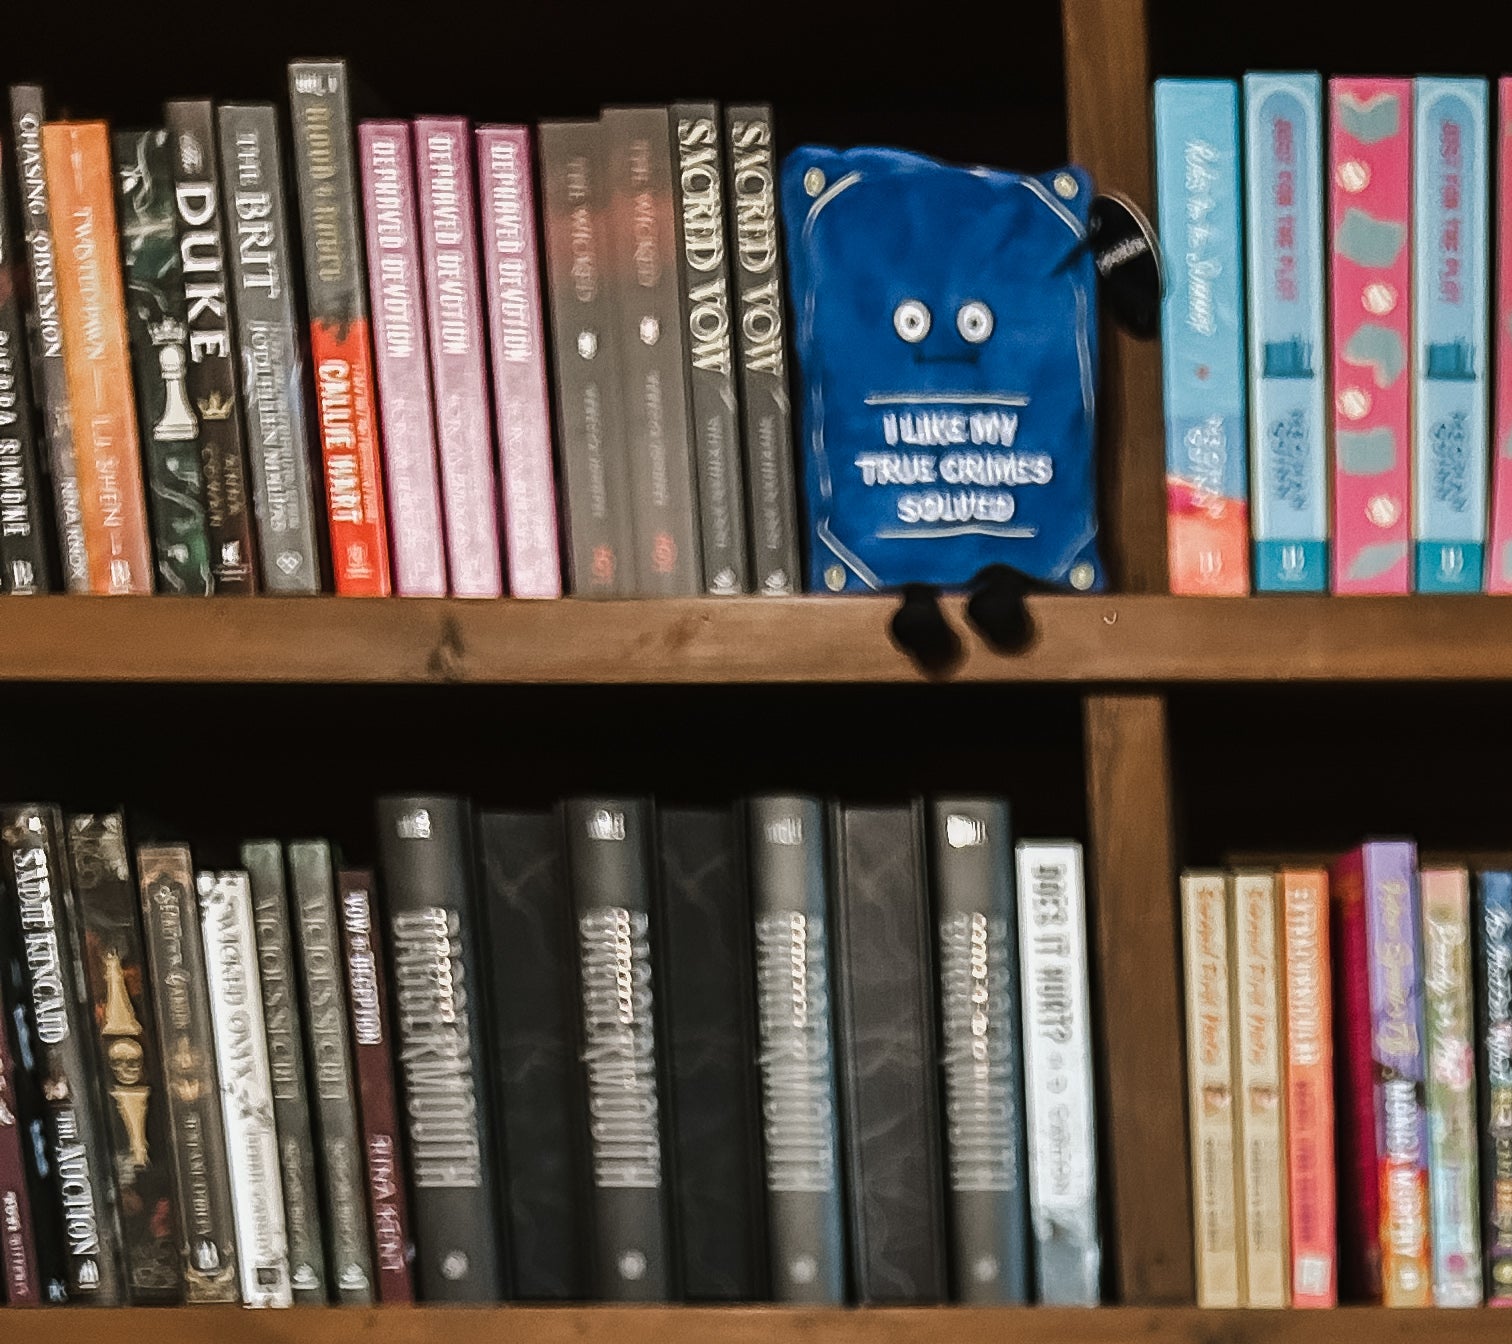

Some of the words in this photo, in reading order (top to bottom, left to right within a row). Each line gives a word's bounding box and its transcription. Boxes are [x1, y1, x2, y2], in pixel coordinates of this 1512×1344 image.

[20, 112, 47, 216] CHASING
[236, 133, 258, 185] THE
[372, 141, 407, 248] DEPRAVED
[428, 137, 462, 245] DEPRAVED
[490, 144, 525, 253] DEPRAVED
[678, 119, 723, 272] SACRED
[731, 121, 775, 273] SACRED
[175, 182, 229, 364] DUKE
[236, 192, 277, 299] BRIT
[30, 235, 62, 358] OBSESSION
[381, 258, 411, 358] DEVOTION
[435, 253, 467, 354] DEVOTION
[499, 261, 531, 362] DEVOTION
[688, 278, 730, 376] VOW
[741, 280, 783, 376] VOW
[320, 359, 354, 448] CALLIE
[884, 413, 897, 445] I
[899, 412, 968, 446] LIKE
[971, 411, 1019, 447] MY
[329, 455, 360, 524] HART
[855, 455, 936, 485] TRUE
[940, 455, 1052, 486] CRIMES
[898, 492, 1015, 523] SOLVED
[13, 848, 53, 929] SADIE
[1032, 864, 1070, 926] DOES
[24, 933, 70, 1044] KINCAID
[1035, 931, 1070, 957] IT
[348, 954, 383, 1046] DECEPTION
[394, 906, 482, 1188] DAGGERMOUTH
[578, 908, 661, 1188] DAGGERMOUTH
[1035, 968, 1074, 1045] HURT?
[57, 1143, 99, 1256] AUCTION
[369, 1134, 398, 1200] RINA
[378, 1206, 404, 1272] KENT
